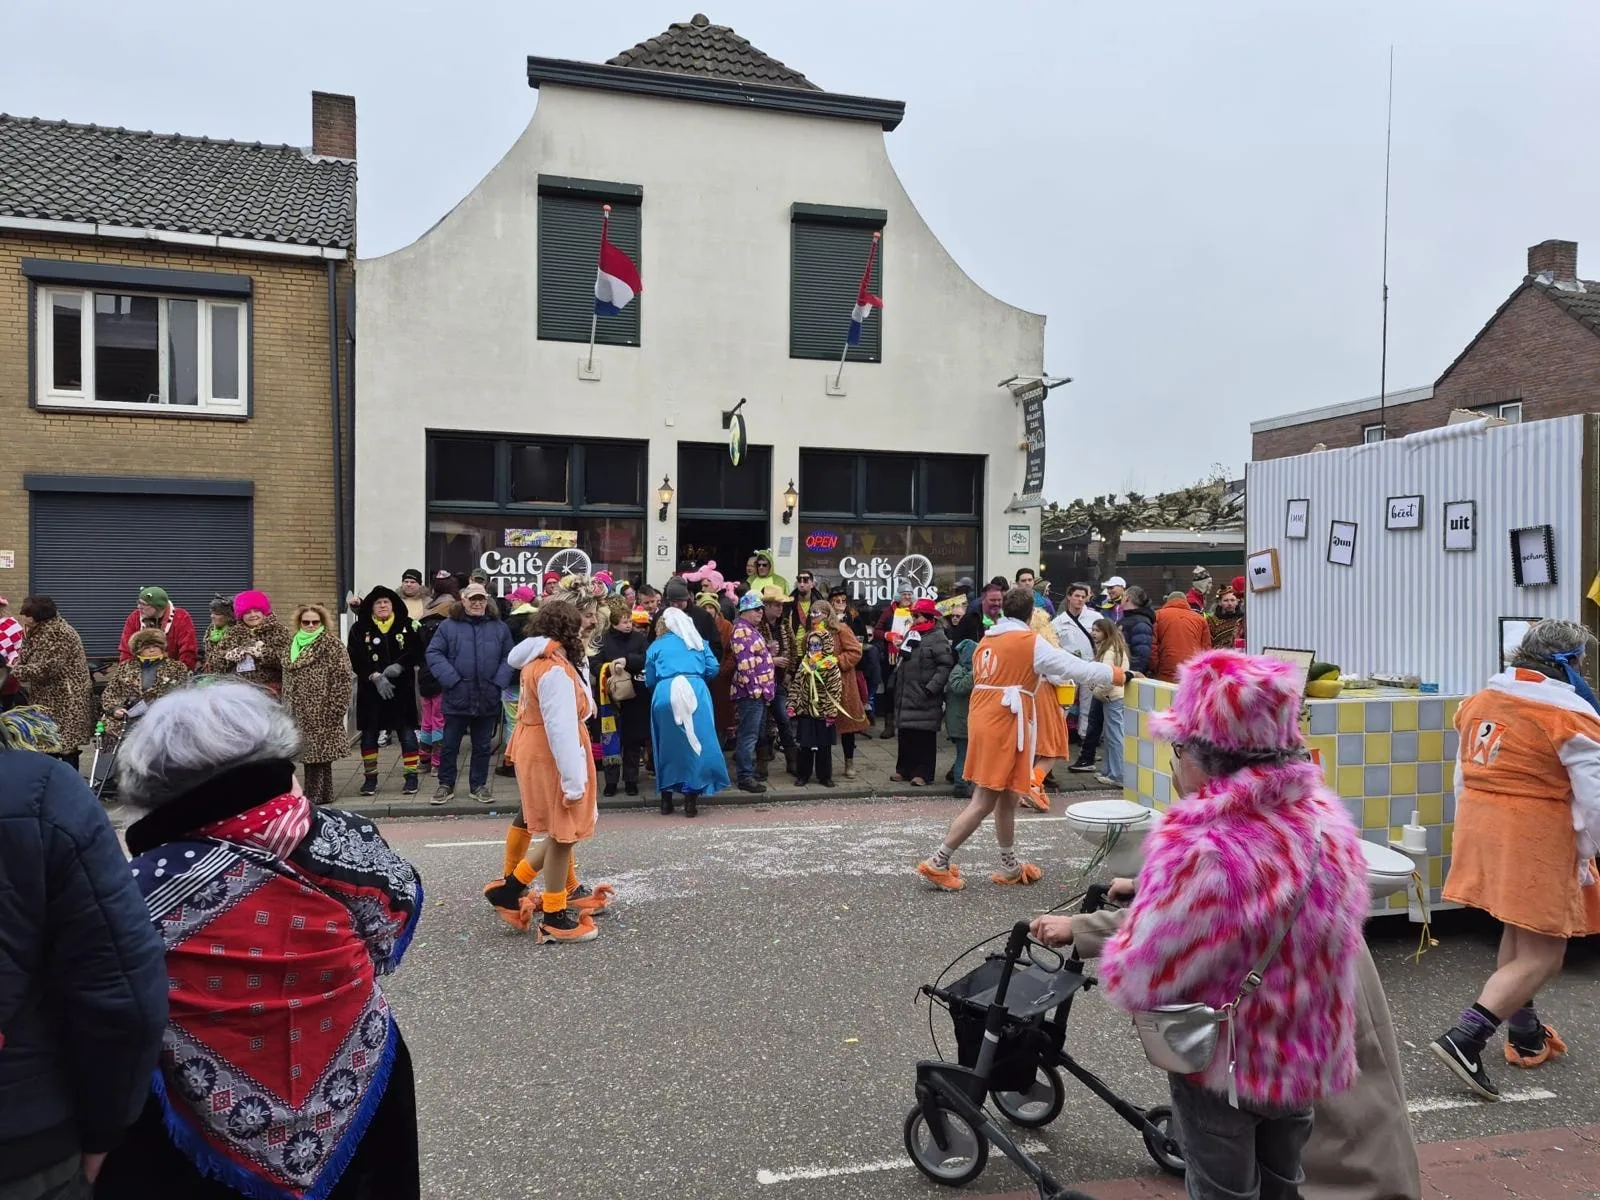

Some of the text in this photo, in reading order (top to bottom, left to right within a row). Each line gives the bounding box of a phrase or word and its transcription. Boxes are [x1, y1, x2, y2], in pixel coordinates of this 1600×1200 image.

[1391, 503, 1416, 519] beest
[1450, 516, 1470, 530] uit
[805, 535, 839, 549] OPEN
[480, 551, 543, 575] Café
[839, 556, 892, 579] Café
[1254, 567, 1267, 576] We
[847, 576, 939, 606] Tijdlos
